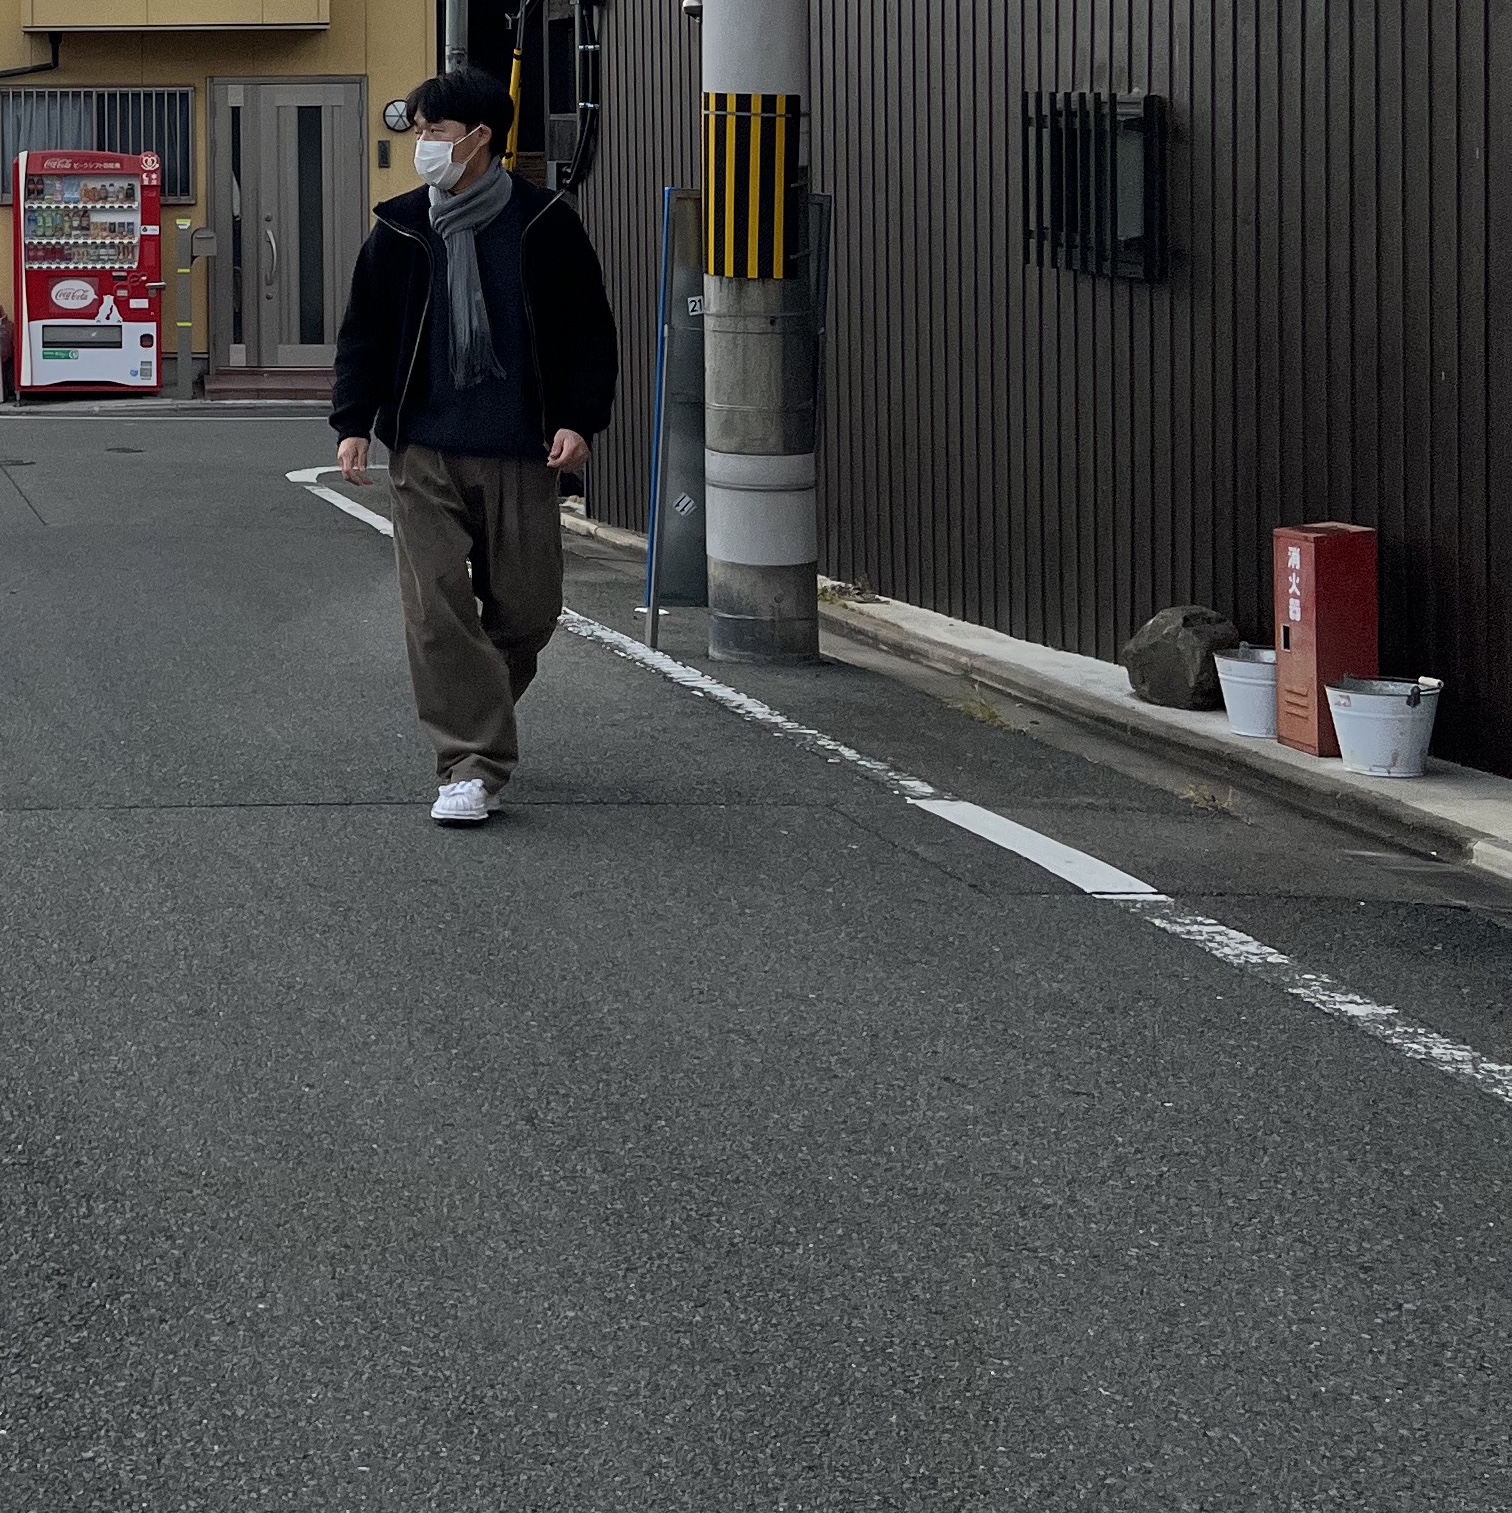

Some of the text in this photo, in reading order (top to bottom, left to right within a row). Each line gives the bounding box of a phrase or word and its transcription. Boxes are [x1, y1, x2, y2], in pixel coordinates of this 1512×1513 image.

[689, 299, 702, 313] 21
[674, 495, 692, 512] 11
[1288, 546, 1301, 621] 消火器
